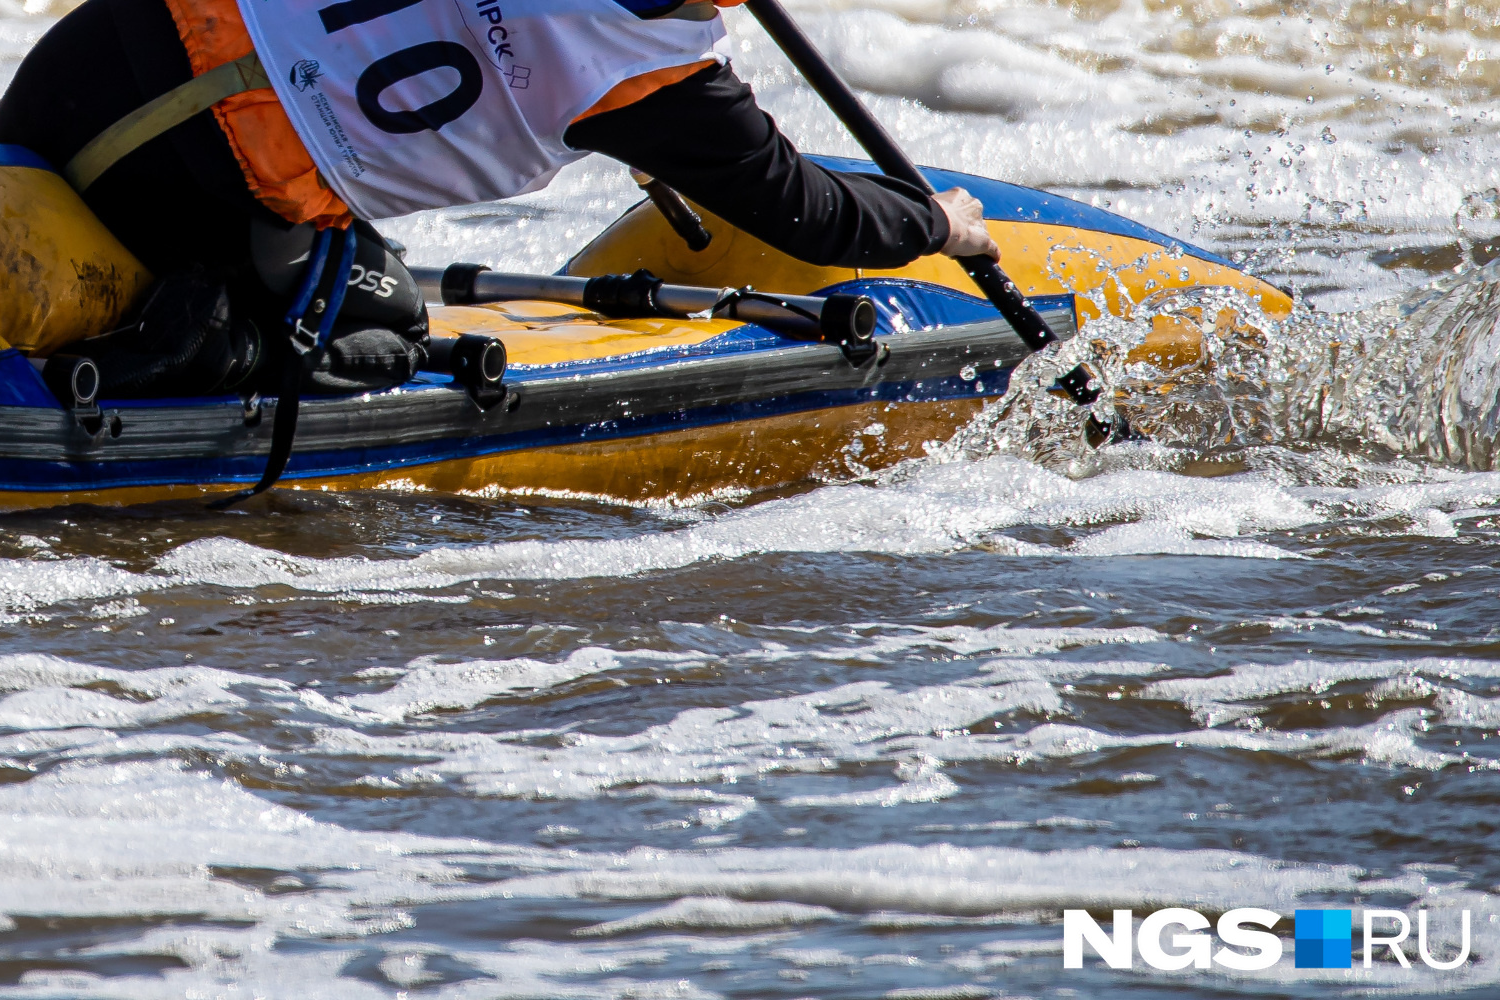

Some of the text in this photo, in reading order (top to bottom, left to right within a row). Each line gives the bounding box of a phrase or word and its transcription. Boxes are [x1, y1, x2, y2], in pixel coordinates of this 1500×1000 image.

[311, 94, 331, 127] СТАНЦИЯ
[329, 128, 343, 148] ЮНЫХ
[317, 92, 348, 142] ИСКИТИМСКАЯ
